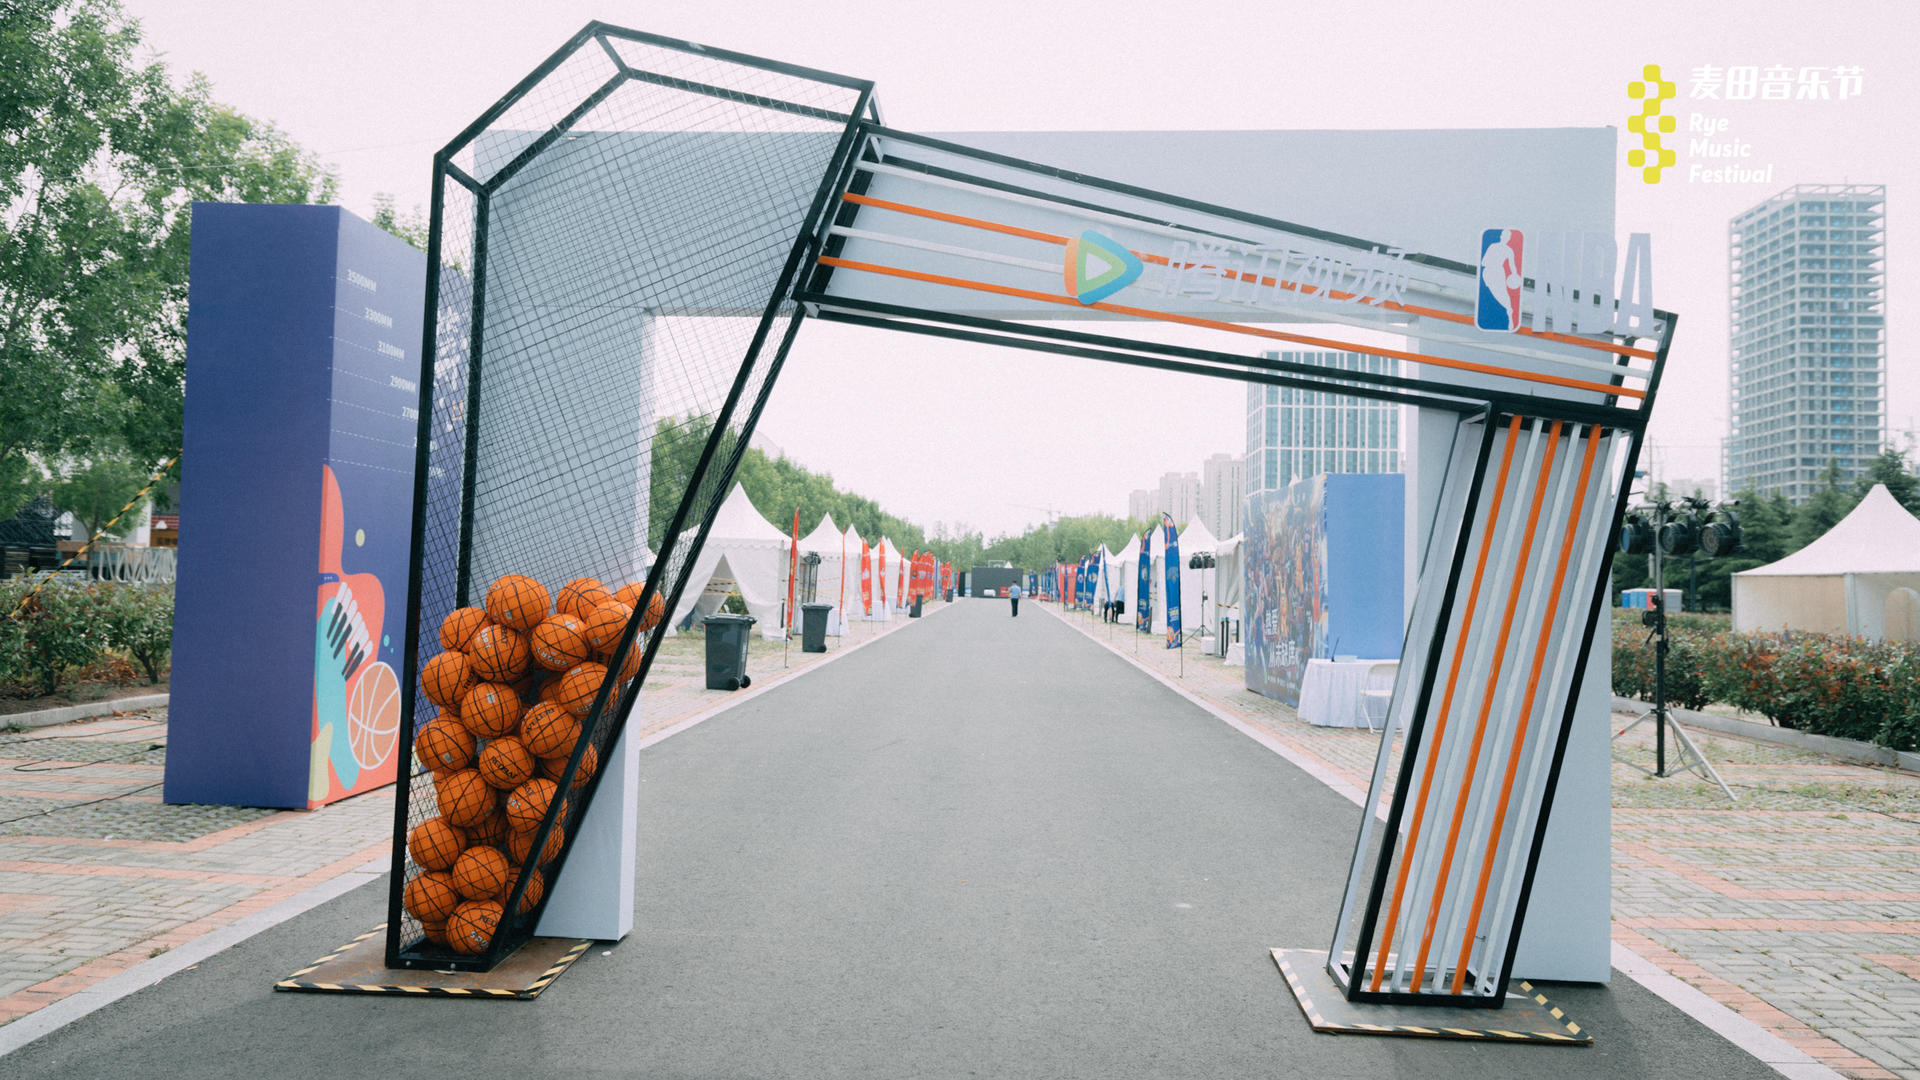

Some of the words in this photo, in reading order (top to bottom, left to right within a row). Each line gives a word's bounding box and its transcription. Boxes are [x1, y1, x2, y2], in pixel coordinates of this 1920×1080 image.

[1159, 240, 1411, 307] 腾讯视频
[1532, 232, 1654, 335] NBA
[469, 930, 489, 948] SPO
[479, 913, 498, 928] RED
